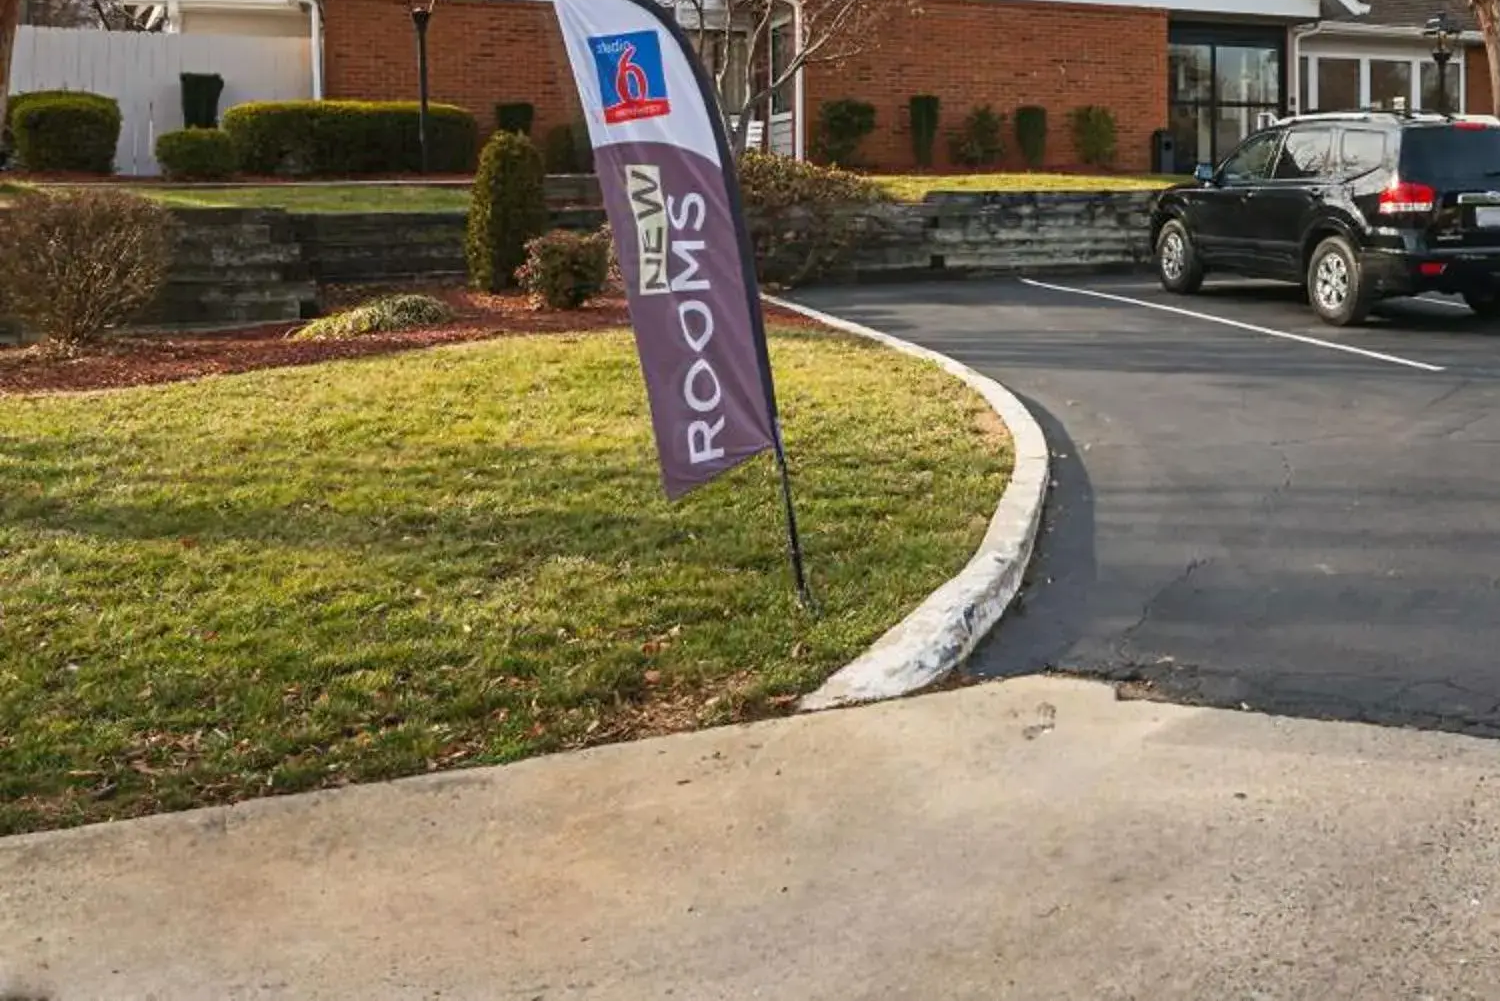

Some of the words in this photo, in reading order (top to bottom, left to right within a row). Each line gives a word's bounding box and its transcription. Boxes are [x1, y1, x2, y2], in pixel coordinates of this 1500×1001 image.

[615, 46, 649, 102] 6
[631, 170, 666, 290] NEW
[667, 192, 725, 465] ROOMS
